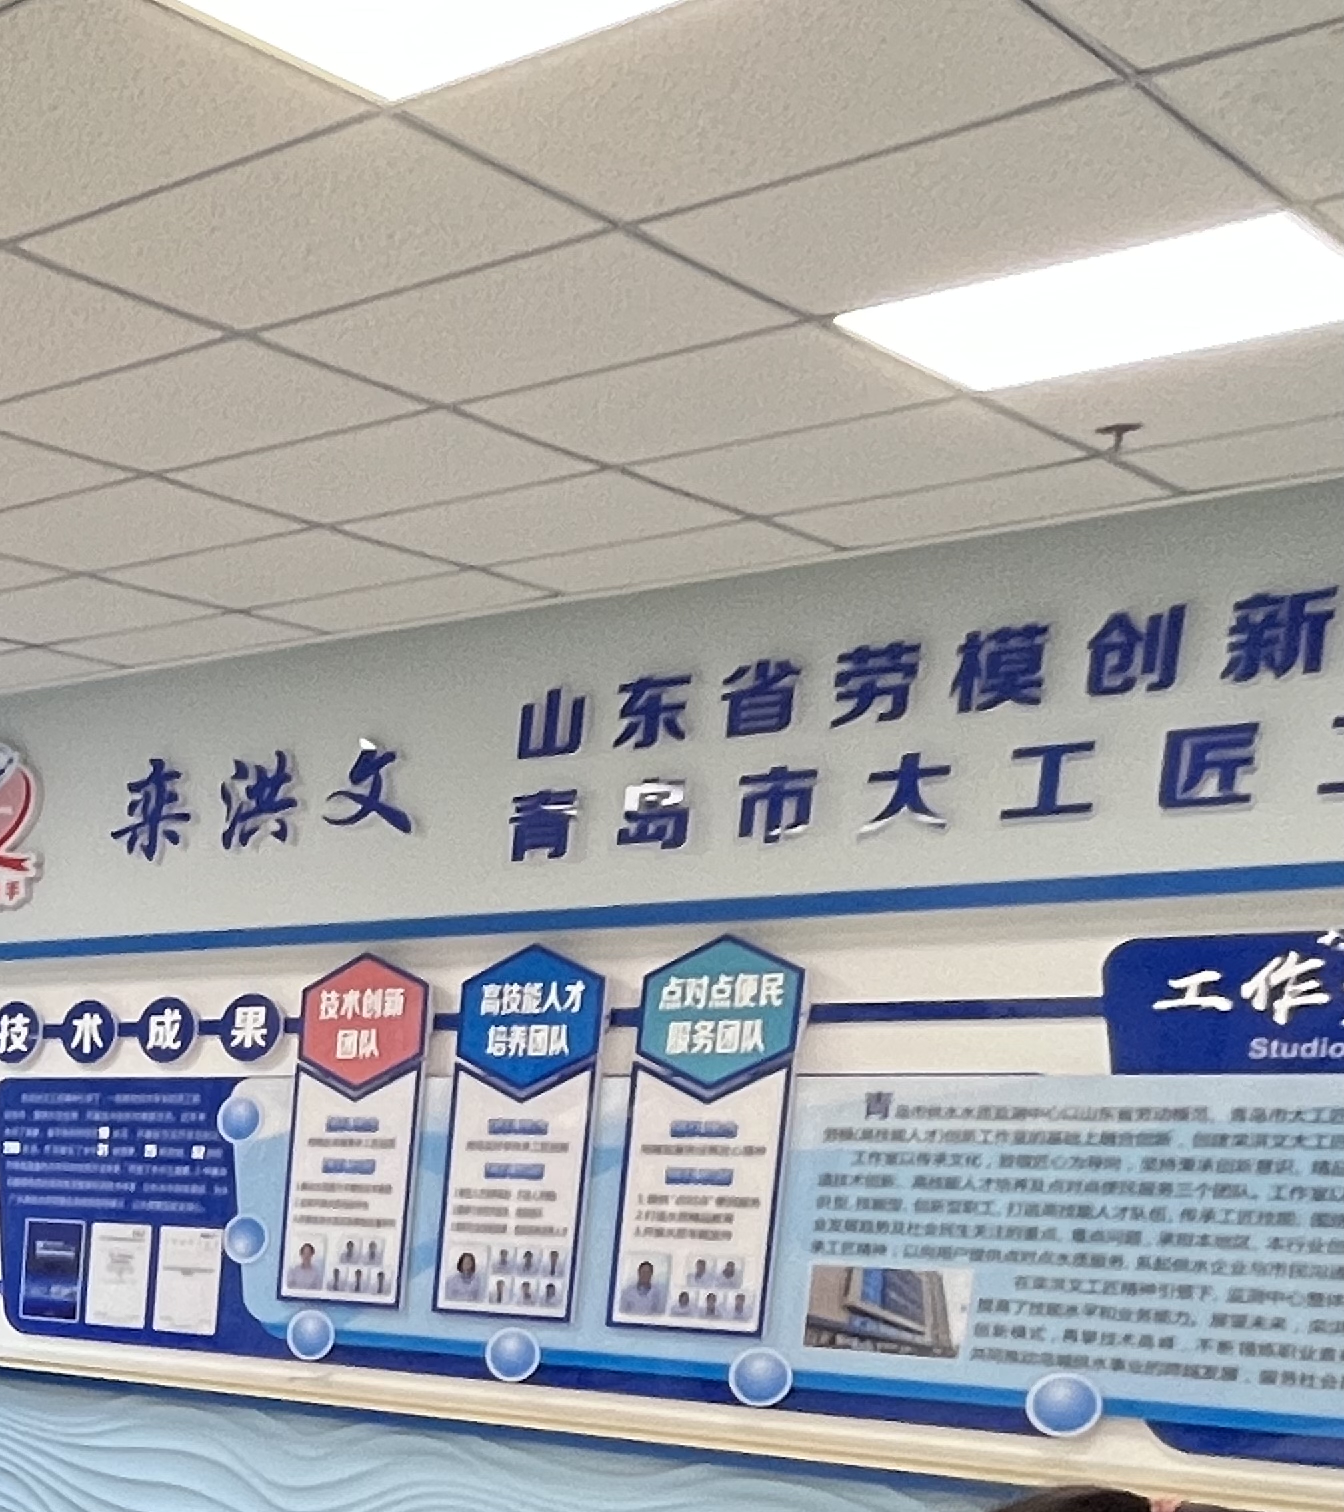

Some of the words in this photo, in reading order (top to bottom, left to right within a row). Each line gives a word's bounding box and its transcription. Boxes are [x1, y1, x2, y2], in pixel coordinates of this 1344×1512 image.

[516, 585, 1341, 760] 山东省劳模创新
[509, 715, 1344, 862] 青岛市大工匠
[318, 988, 405, 1020] 技术创新
[480, 980, 586, 1016] 高技能人才
[658, 972, 785, 1011] 点对点便民
[336, 1028, 380, 1060] 团队
[485, 1024, 570, 1058] 培养团队
[665, 1018, 766, 1055] 服务团队
